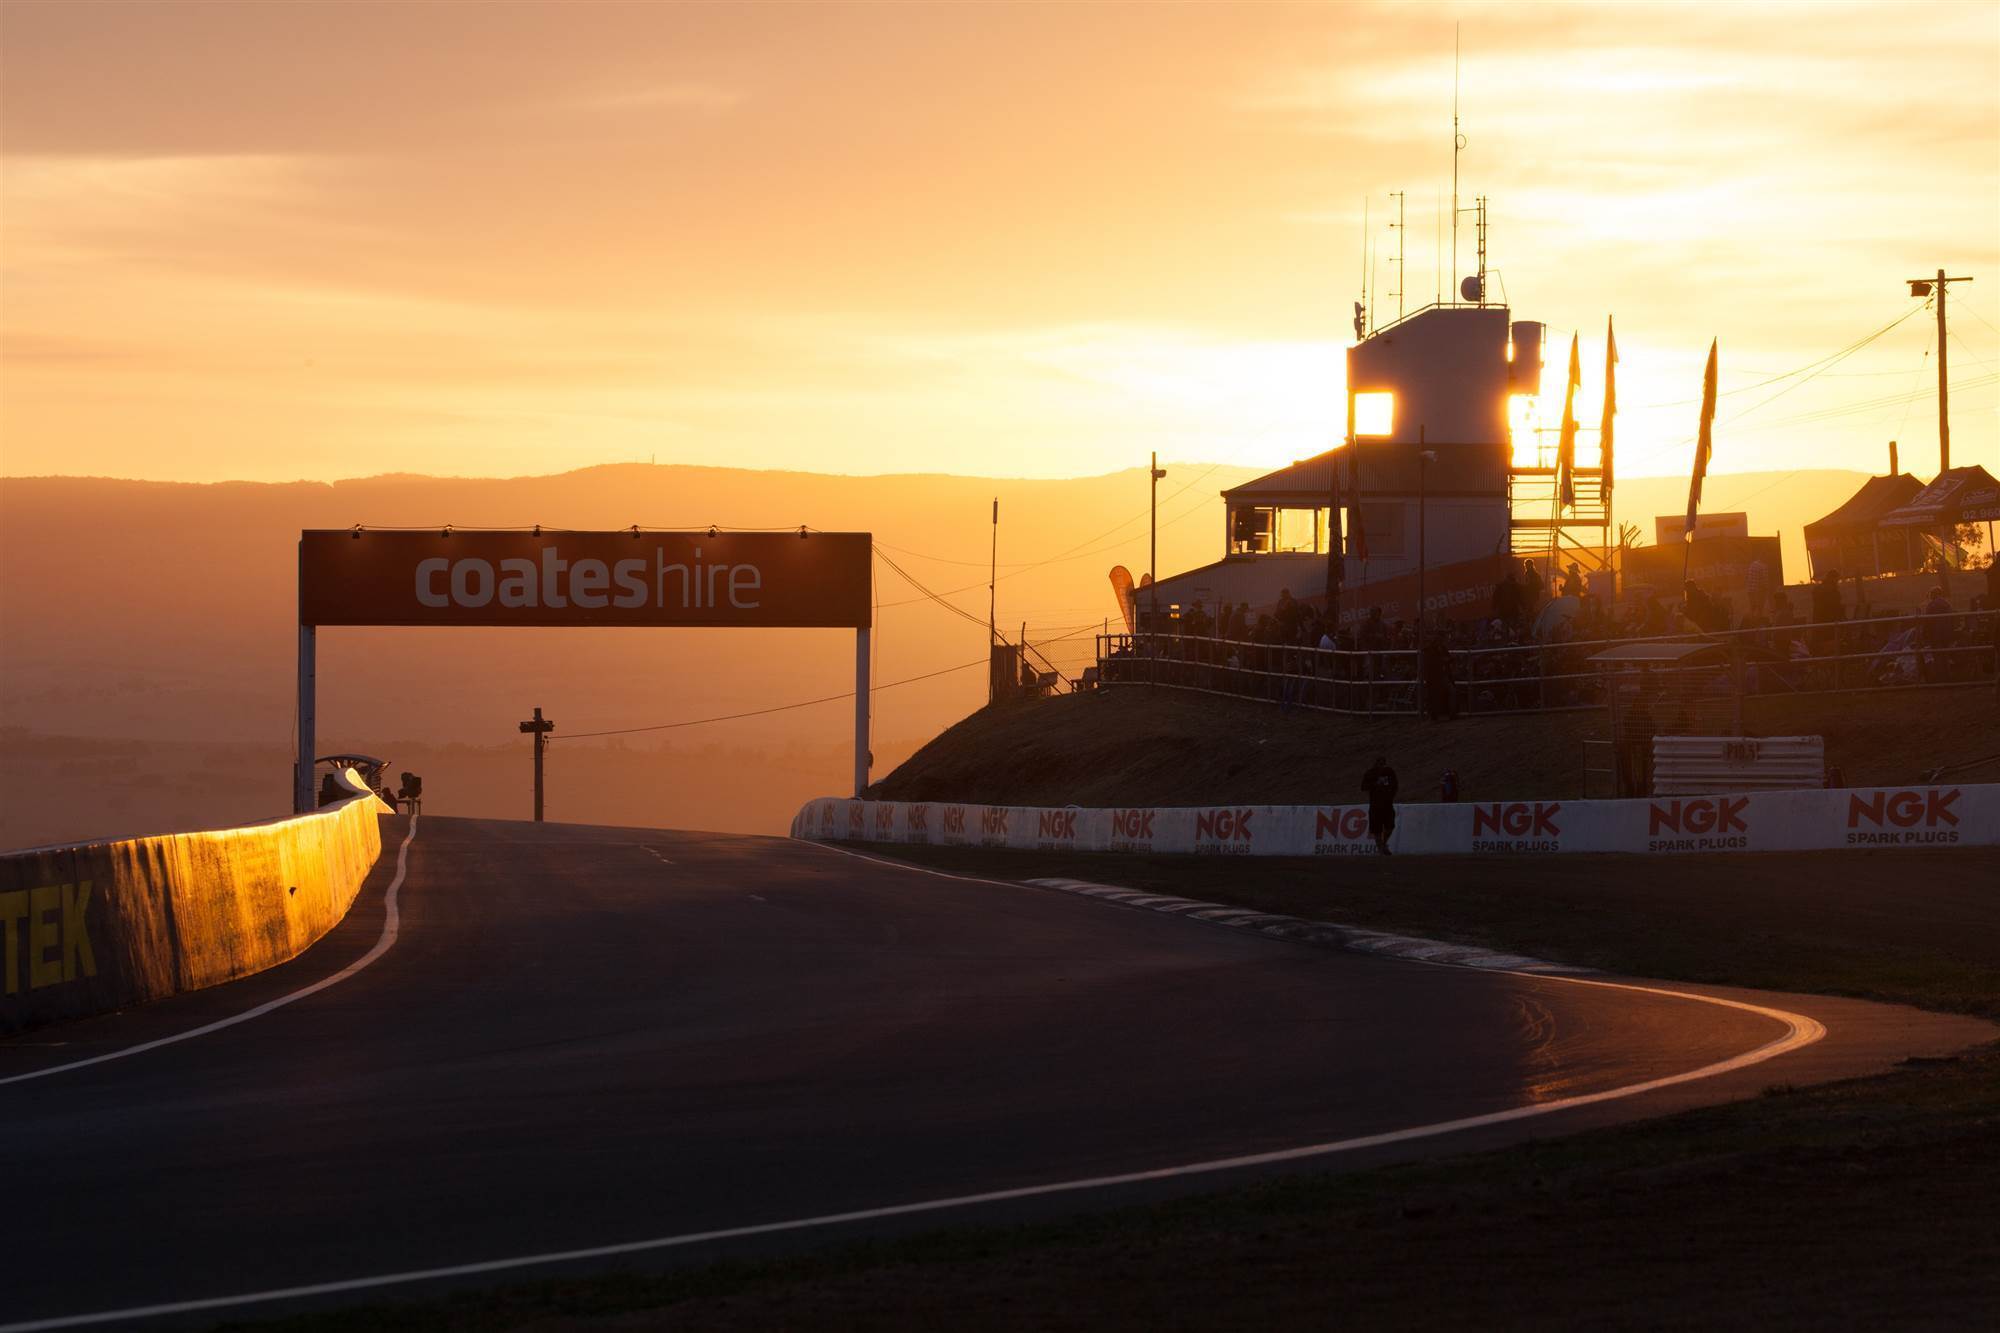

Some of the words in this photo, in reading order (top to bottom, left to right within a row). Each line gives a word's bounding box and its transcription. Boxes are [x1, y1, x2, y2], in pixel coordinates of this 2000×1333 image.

[907, 805, 928, 831] NGK
[943, 806, 965, 833] NGK
[982, 807, 1008, 834] NGK
[1472, 803, 1561, 837] NGK
[1649, 796, 1750, 836] NGK
[1849, 790, 1960, 827] NGK
[1038, 811, 1077, 839] NGK
[1111, 809, 1155, 839] NGK
[1195, 808, 1254, 841] NGK
[1316, 808, 1374, 840] NG
[1847, 832, 1901, 844] SPARK
[1905, 831, 1960, 843] PLUGS
[1195, 844, 1221, 854] SPARK
[1223, 844, 1250, 854] PLUGS
[1315, 843, 1347, 855] SPARK
[1351, 843, 1378, 855] PLU
[1473, 840, 1512, 852] SPARK
[1515, 840, 1560, 852] PLUGS
[1649, 839, 1695, 851] SPARK
[1699, 836, 1748, 849] PLUGS
[0, 880, 97, 994] TEK
